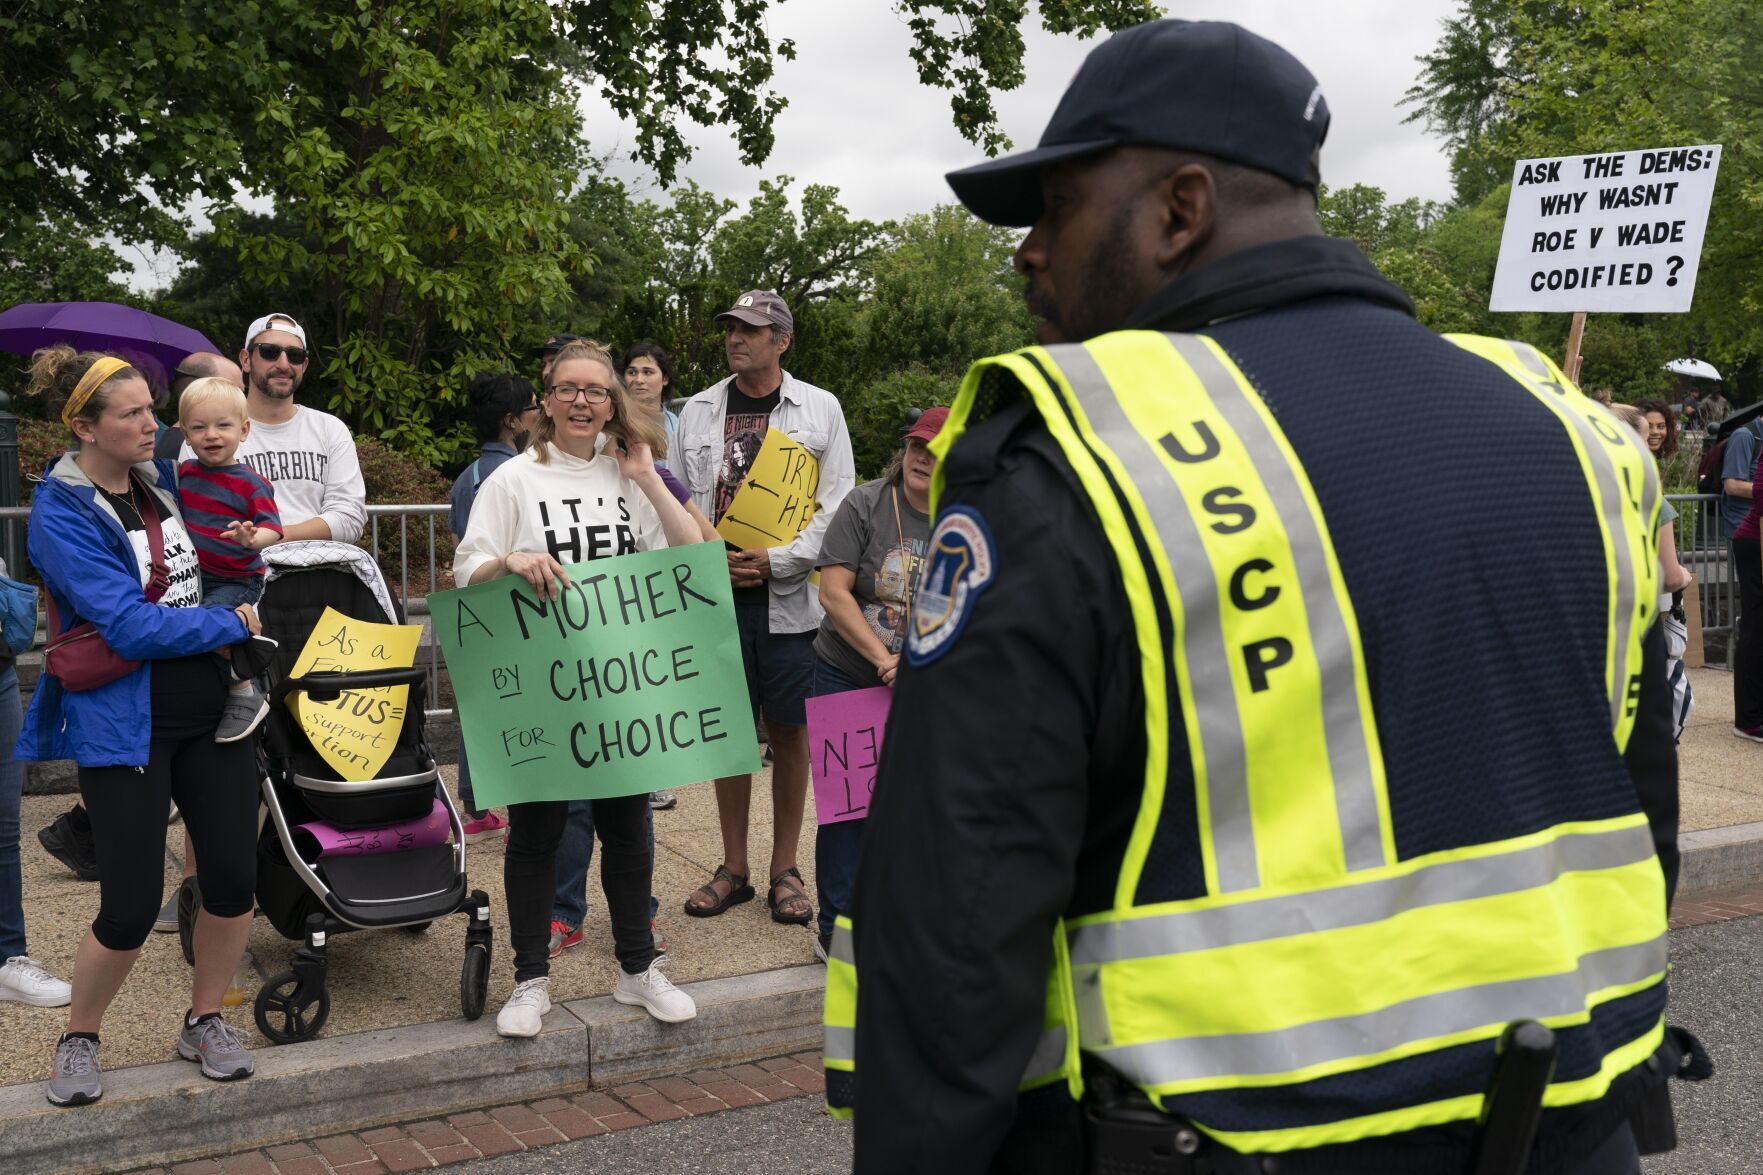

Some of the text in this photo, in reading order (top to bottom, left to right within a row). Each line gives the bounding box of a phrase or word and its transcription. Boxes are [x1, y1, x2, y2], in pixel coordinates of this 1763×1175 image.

[1518, 149, 1713, 186] ASK THE DEMS:
[1540, 182, 1679, 217] WHY WASNT
[1531, 220, 1686, 253] ROE V WADE
[1530, 263, 1653, 292] CODIFIED
[236, 451, 328, 485] NDERBILT
[539, 496, 631, 527] IT'S
[1158, 420, 1294, 694] USCP
[457, 563, 718, 647] A MOTHER
[318, 625, 393, 660] As a
[492, 645, 700, 701] BY CHOICE
[500, 707, 727, 768] FOR CHOICE
